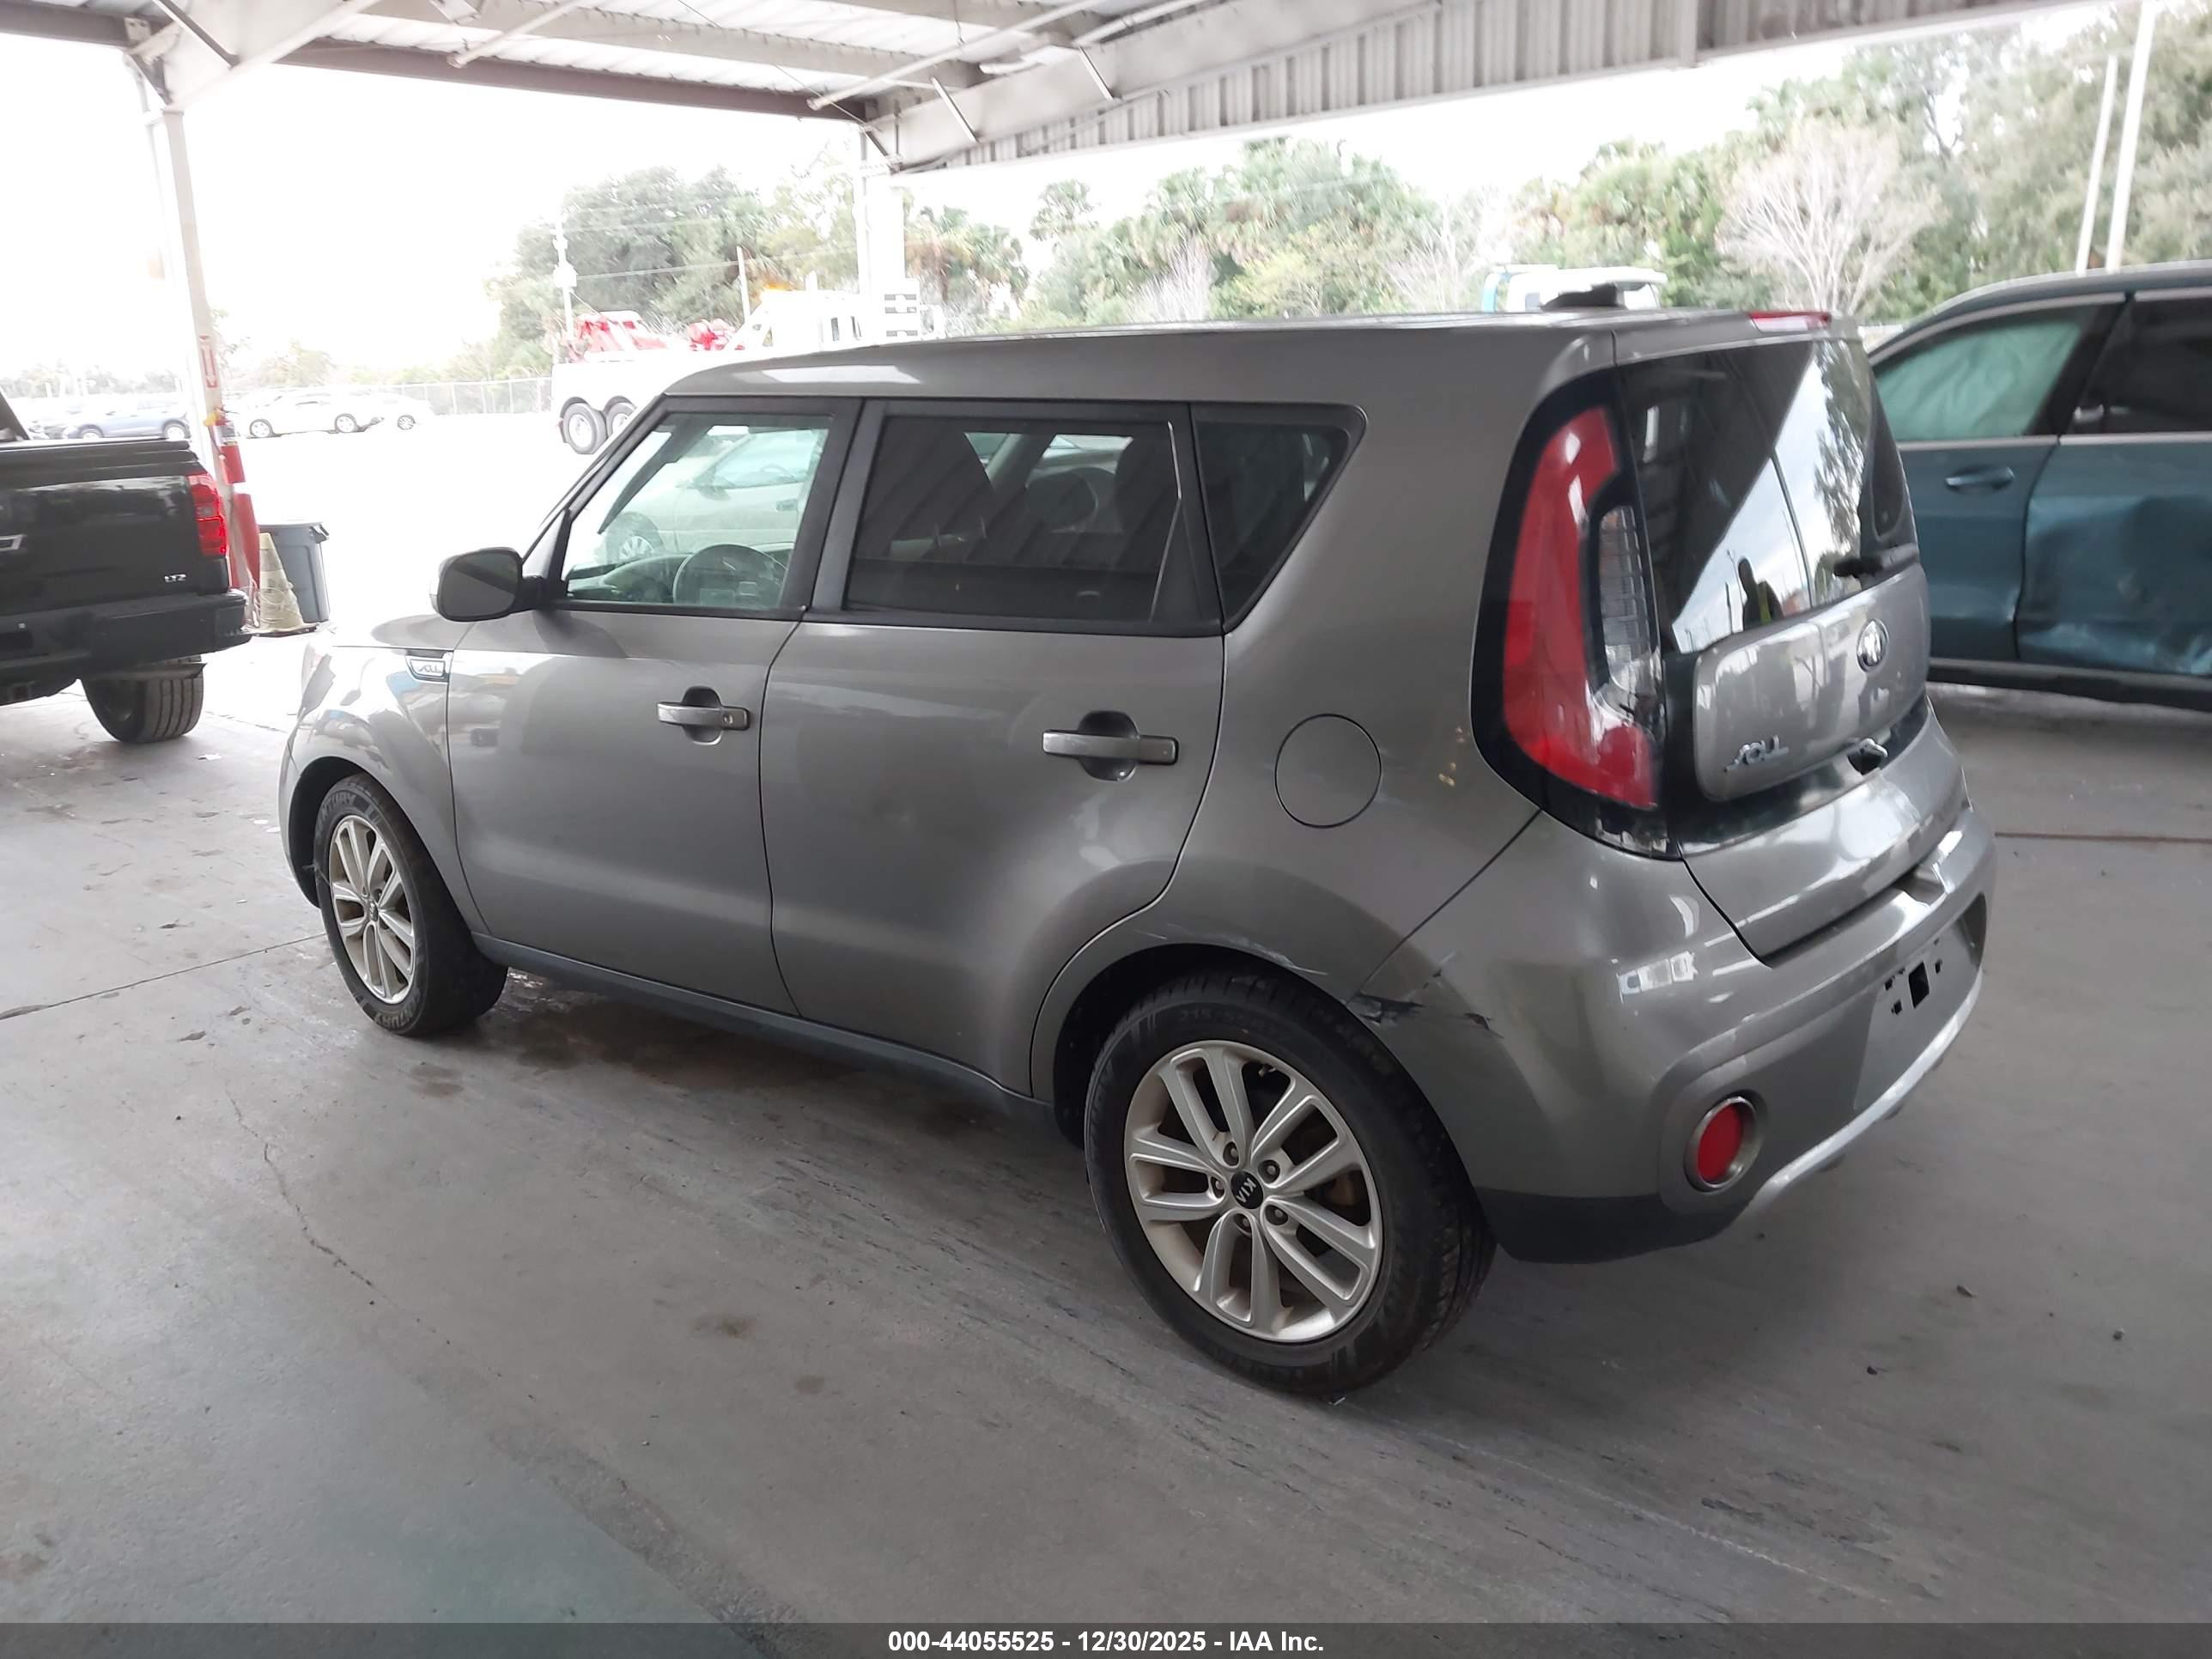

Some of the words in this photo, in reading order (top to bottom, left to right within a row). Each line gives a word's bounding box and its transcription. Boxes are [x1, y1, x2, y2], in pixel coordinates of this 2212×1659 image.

[164, 574, 186, 583] LTZ
[1724, 734, 1789, 771] SOUL
[1236, 1177, 1256, 1203] KIA
